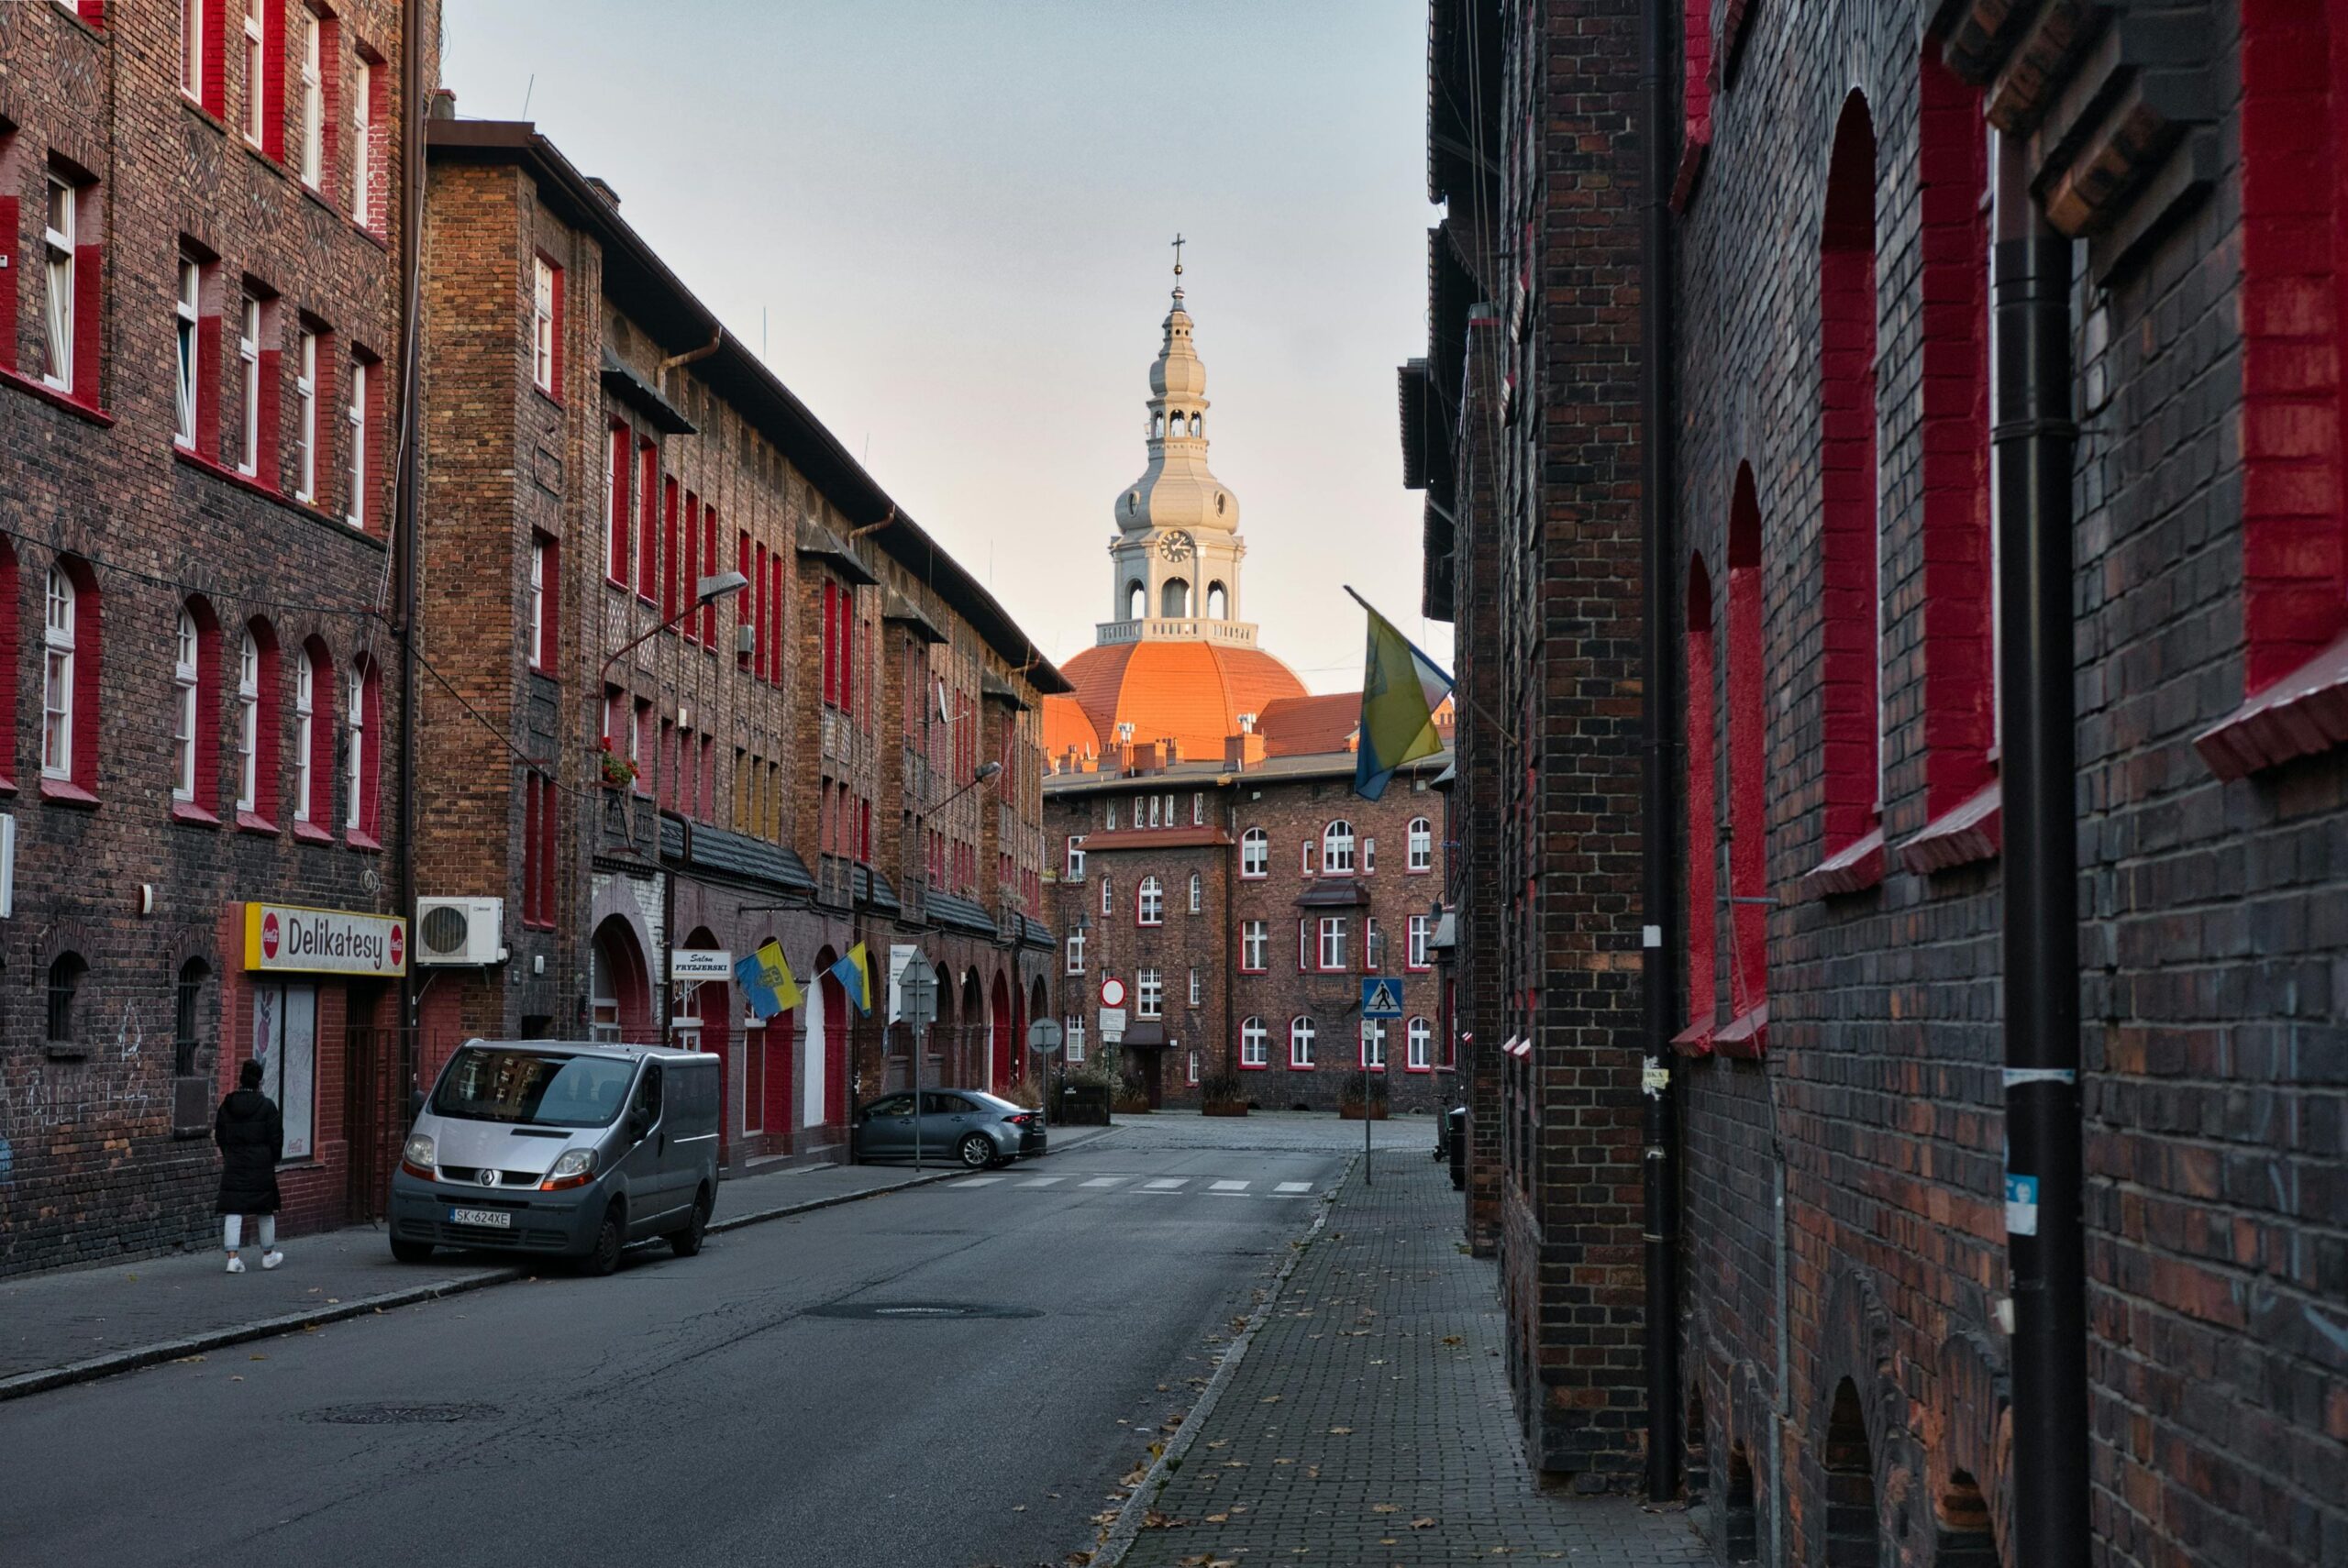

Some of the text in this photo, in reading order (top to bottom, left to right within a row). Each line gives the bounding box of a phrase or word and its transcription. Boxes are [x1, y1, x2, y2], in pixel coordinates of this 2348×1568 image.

[288, 918, 383, 970] Delikatesy
[690, 955, 713, 963] Salon
[457, 1210, 508, 1225] SK 624XE
